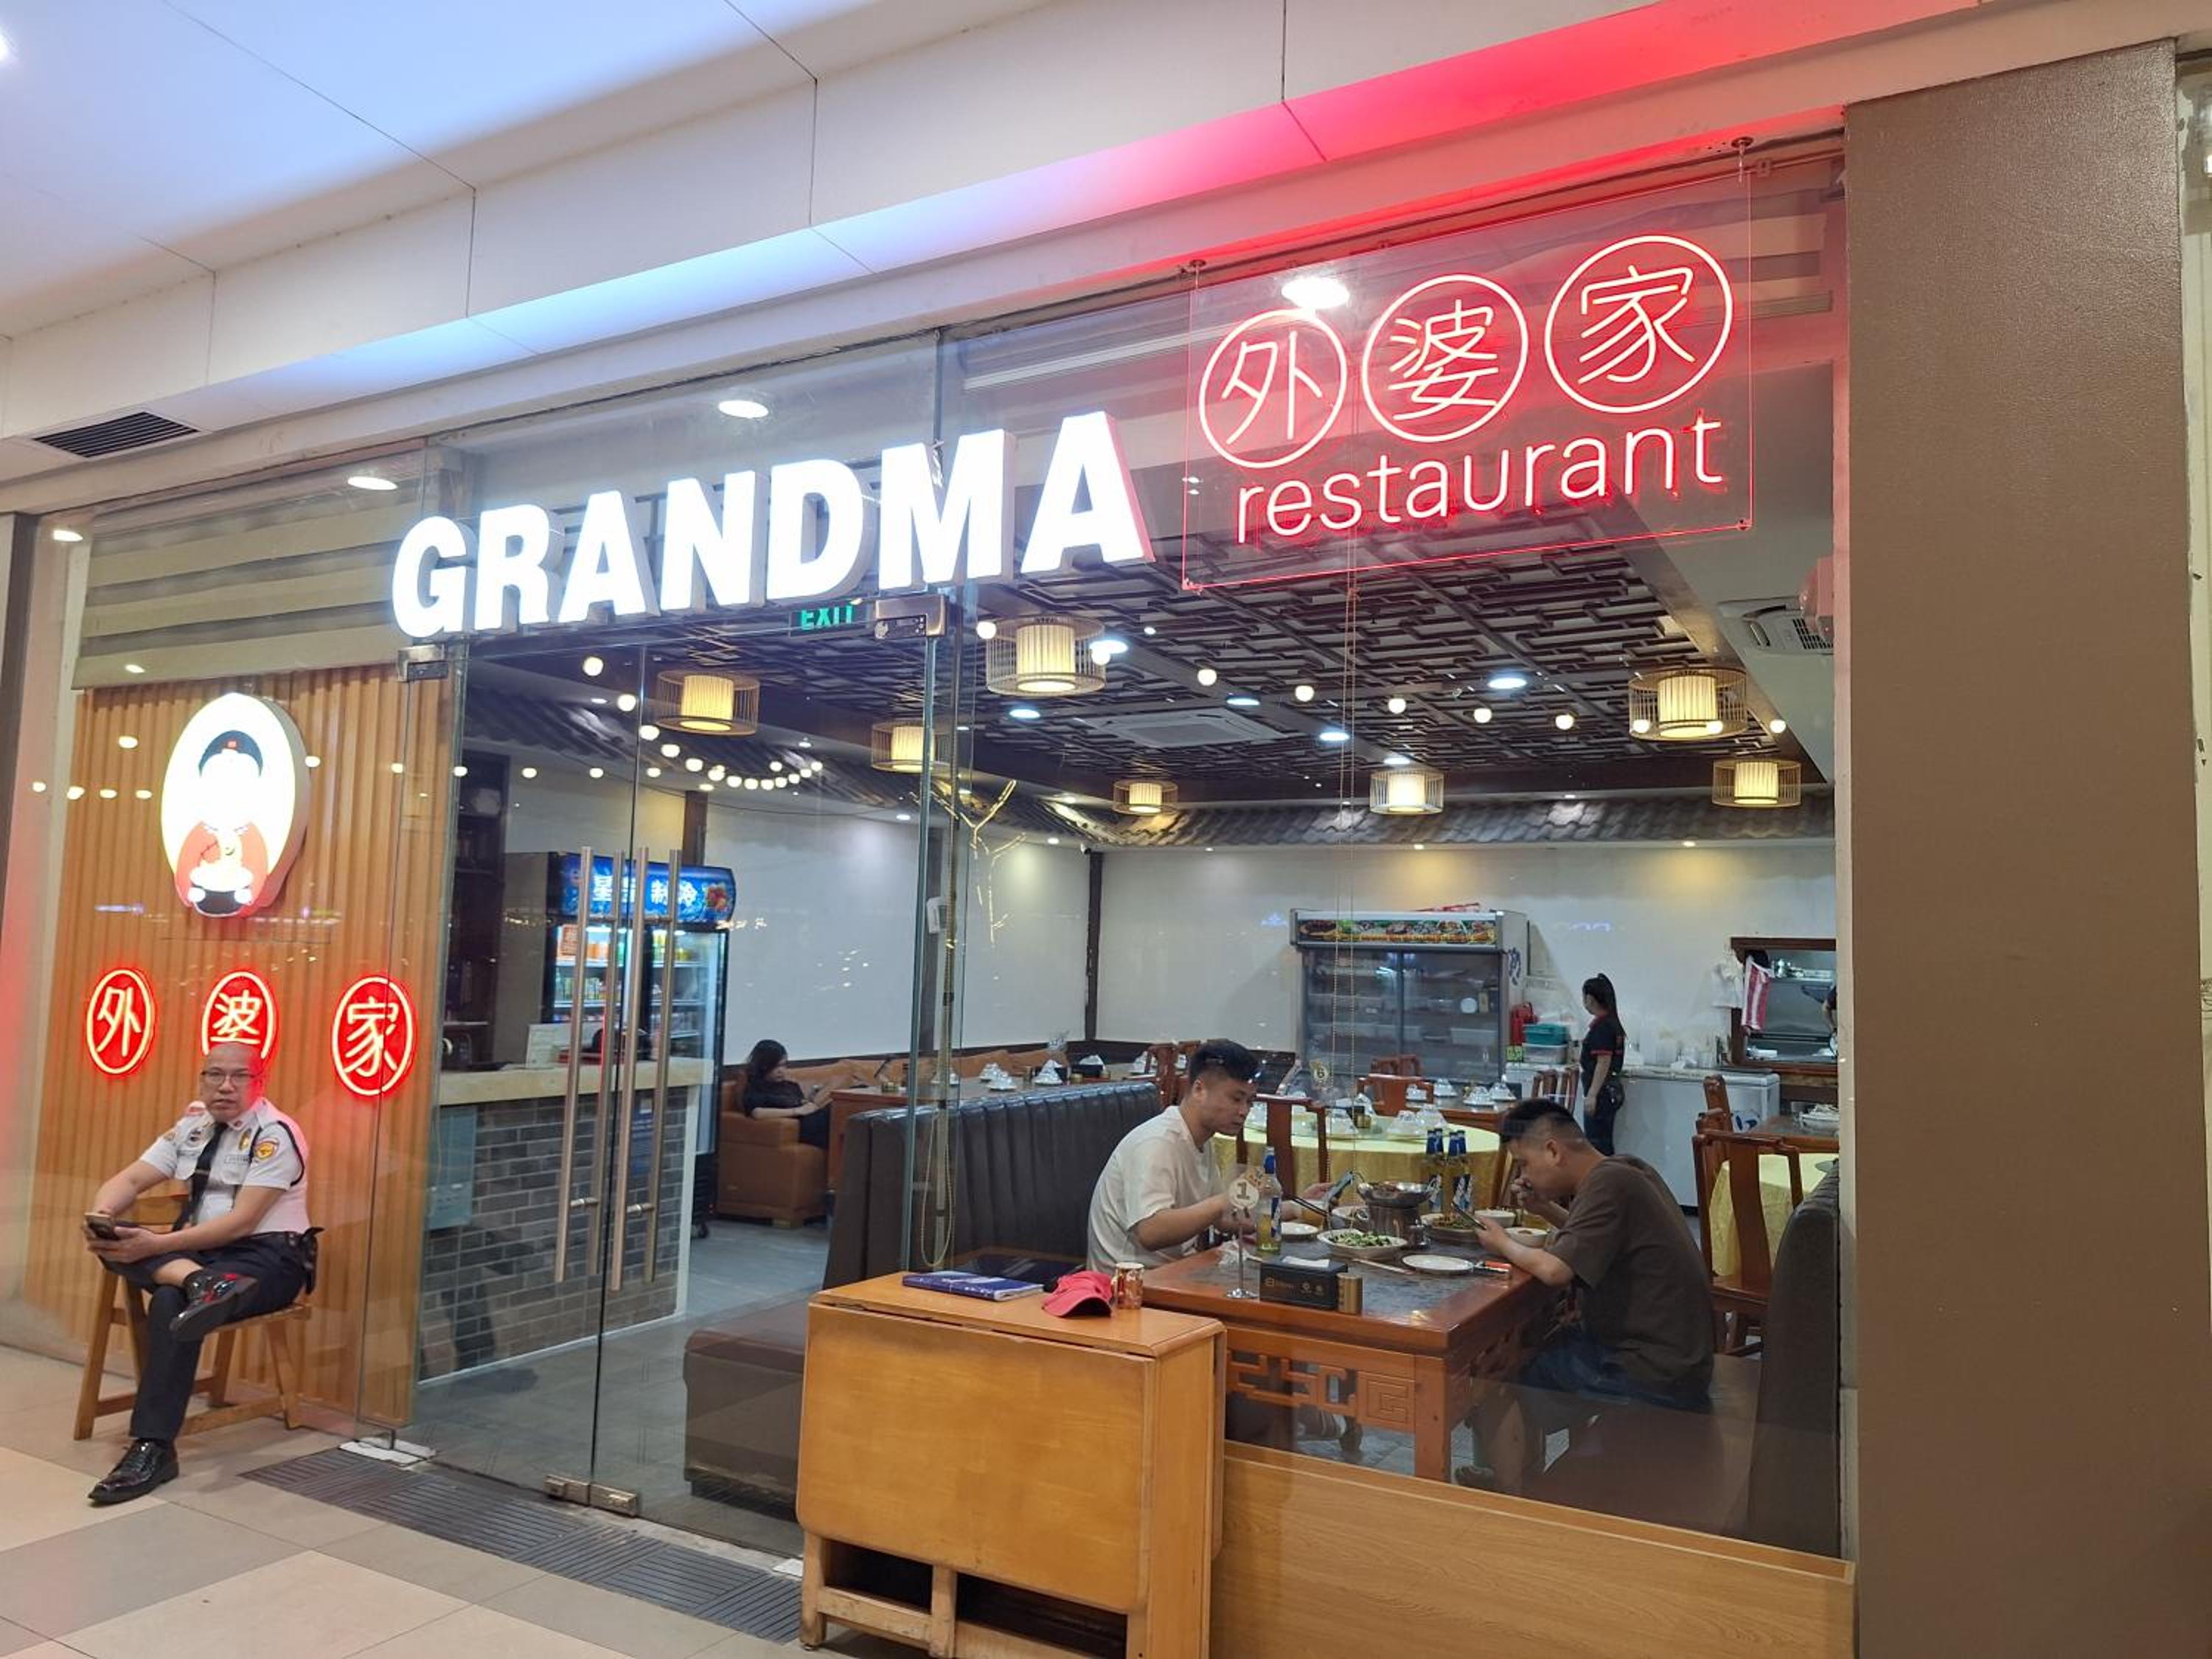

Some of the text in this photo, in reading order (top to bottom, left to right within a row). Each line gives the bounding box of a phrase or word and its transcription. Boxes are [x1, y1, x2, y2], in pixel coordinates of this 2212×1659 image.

[1221, 265, 1695, 445] 外婆家
[393, 411, 1147, 639] GRANDMA
[1237, 411, 1723, 544] restaurant
[96, 987, 399, 1077] 外婆家
[1237, 1182, 1250, 1200] 1
